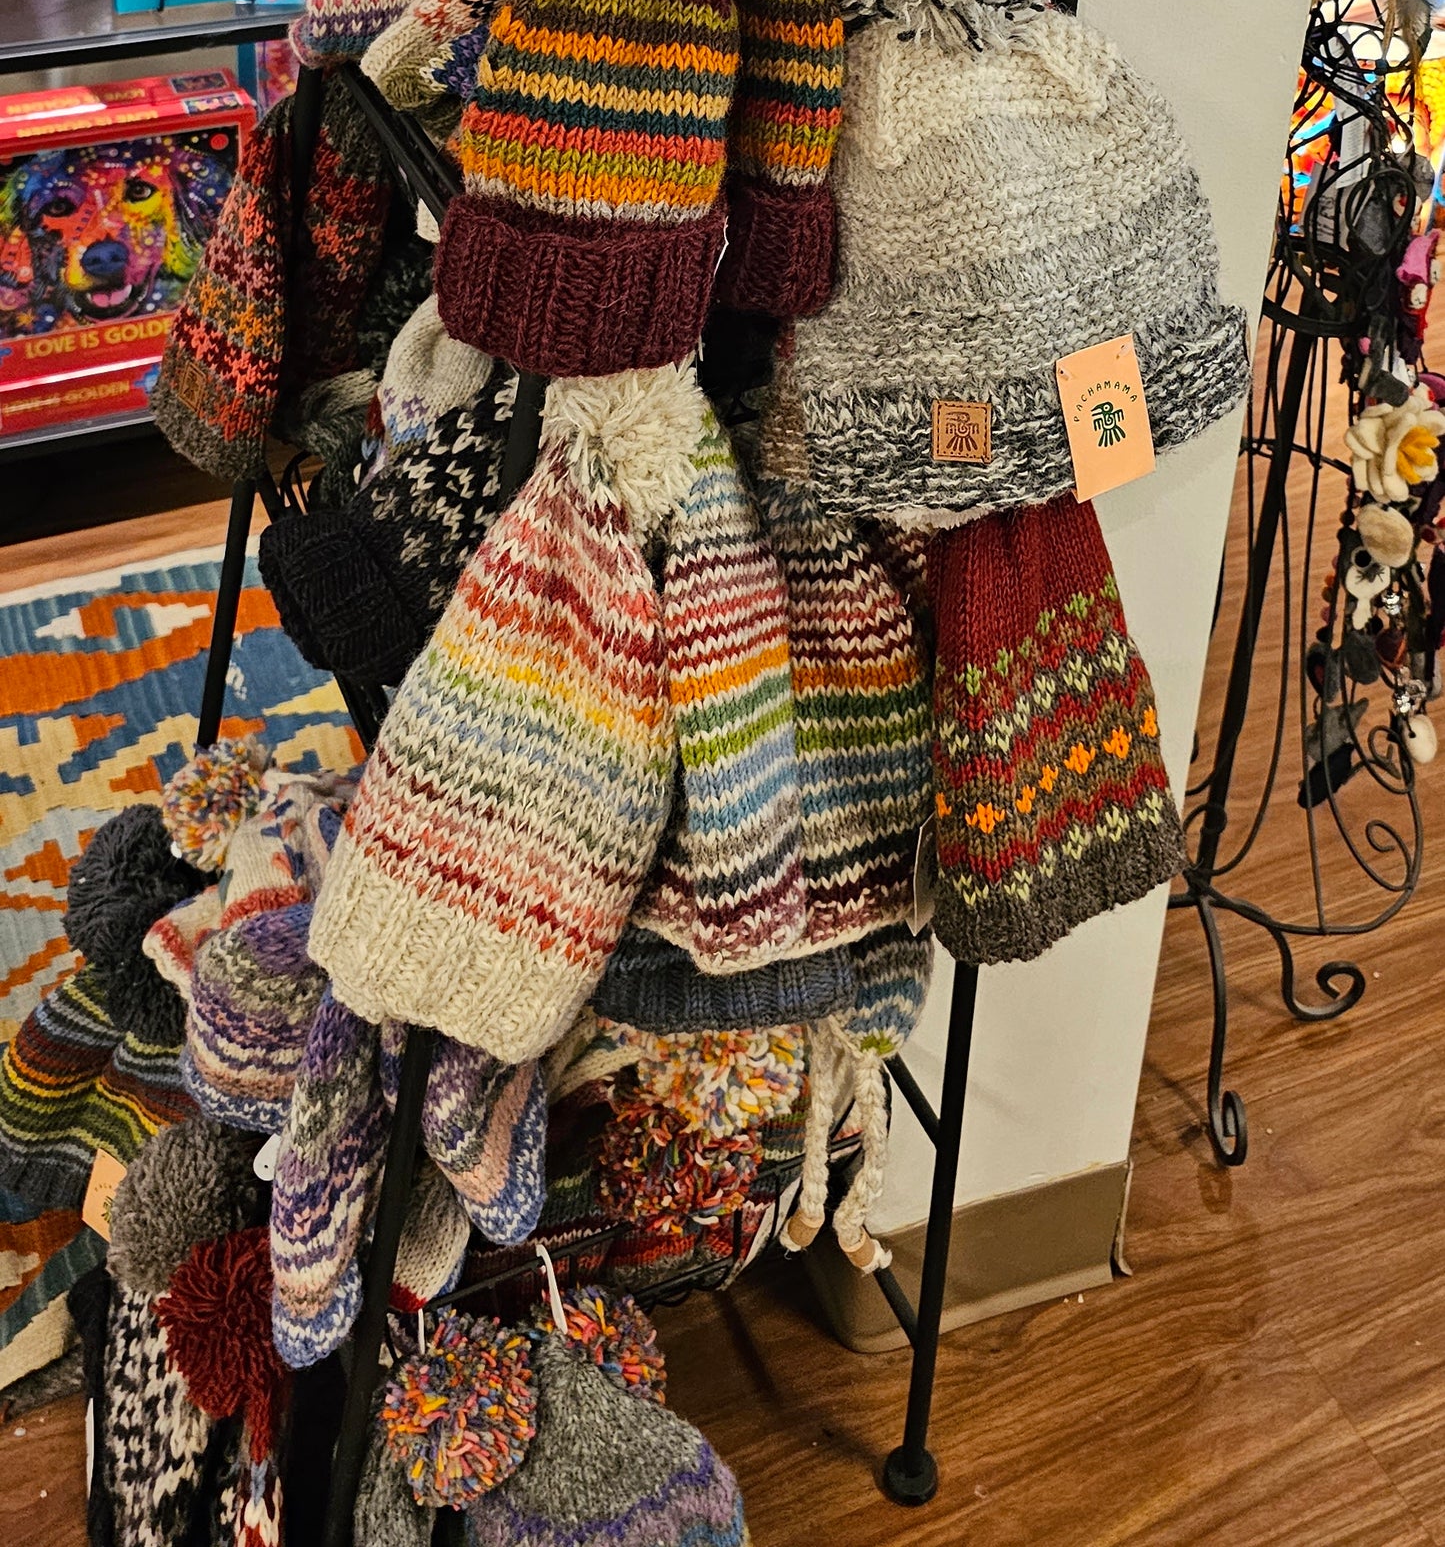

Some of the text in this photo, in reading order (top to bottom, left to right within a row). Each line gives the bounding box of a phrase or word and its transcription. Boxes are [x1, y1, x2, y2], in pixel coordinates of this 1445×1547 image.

[25, 333, 76, 359] LOVE
[80, 330, 100, 348] IS
[1073, 380, 1138, 423] PACHAMAMA
